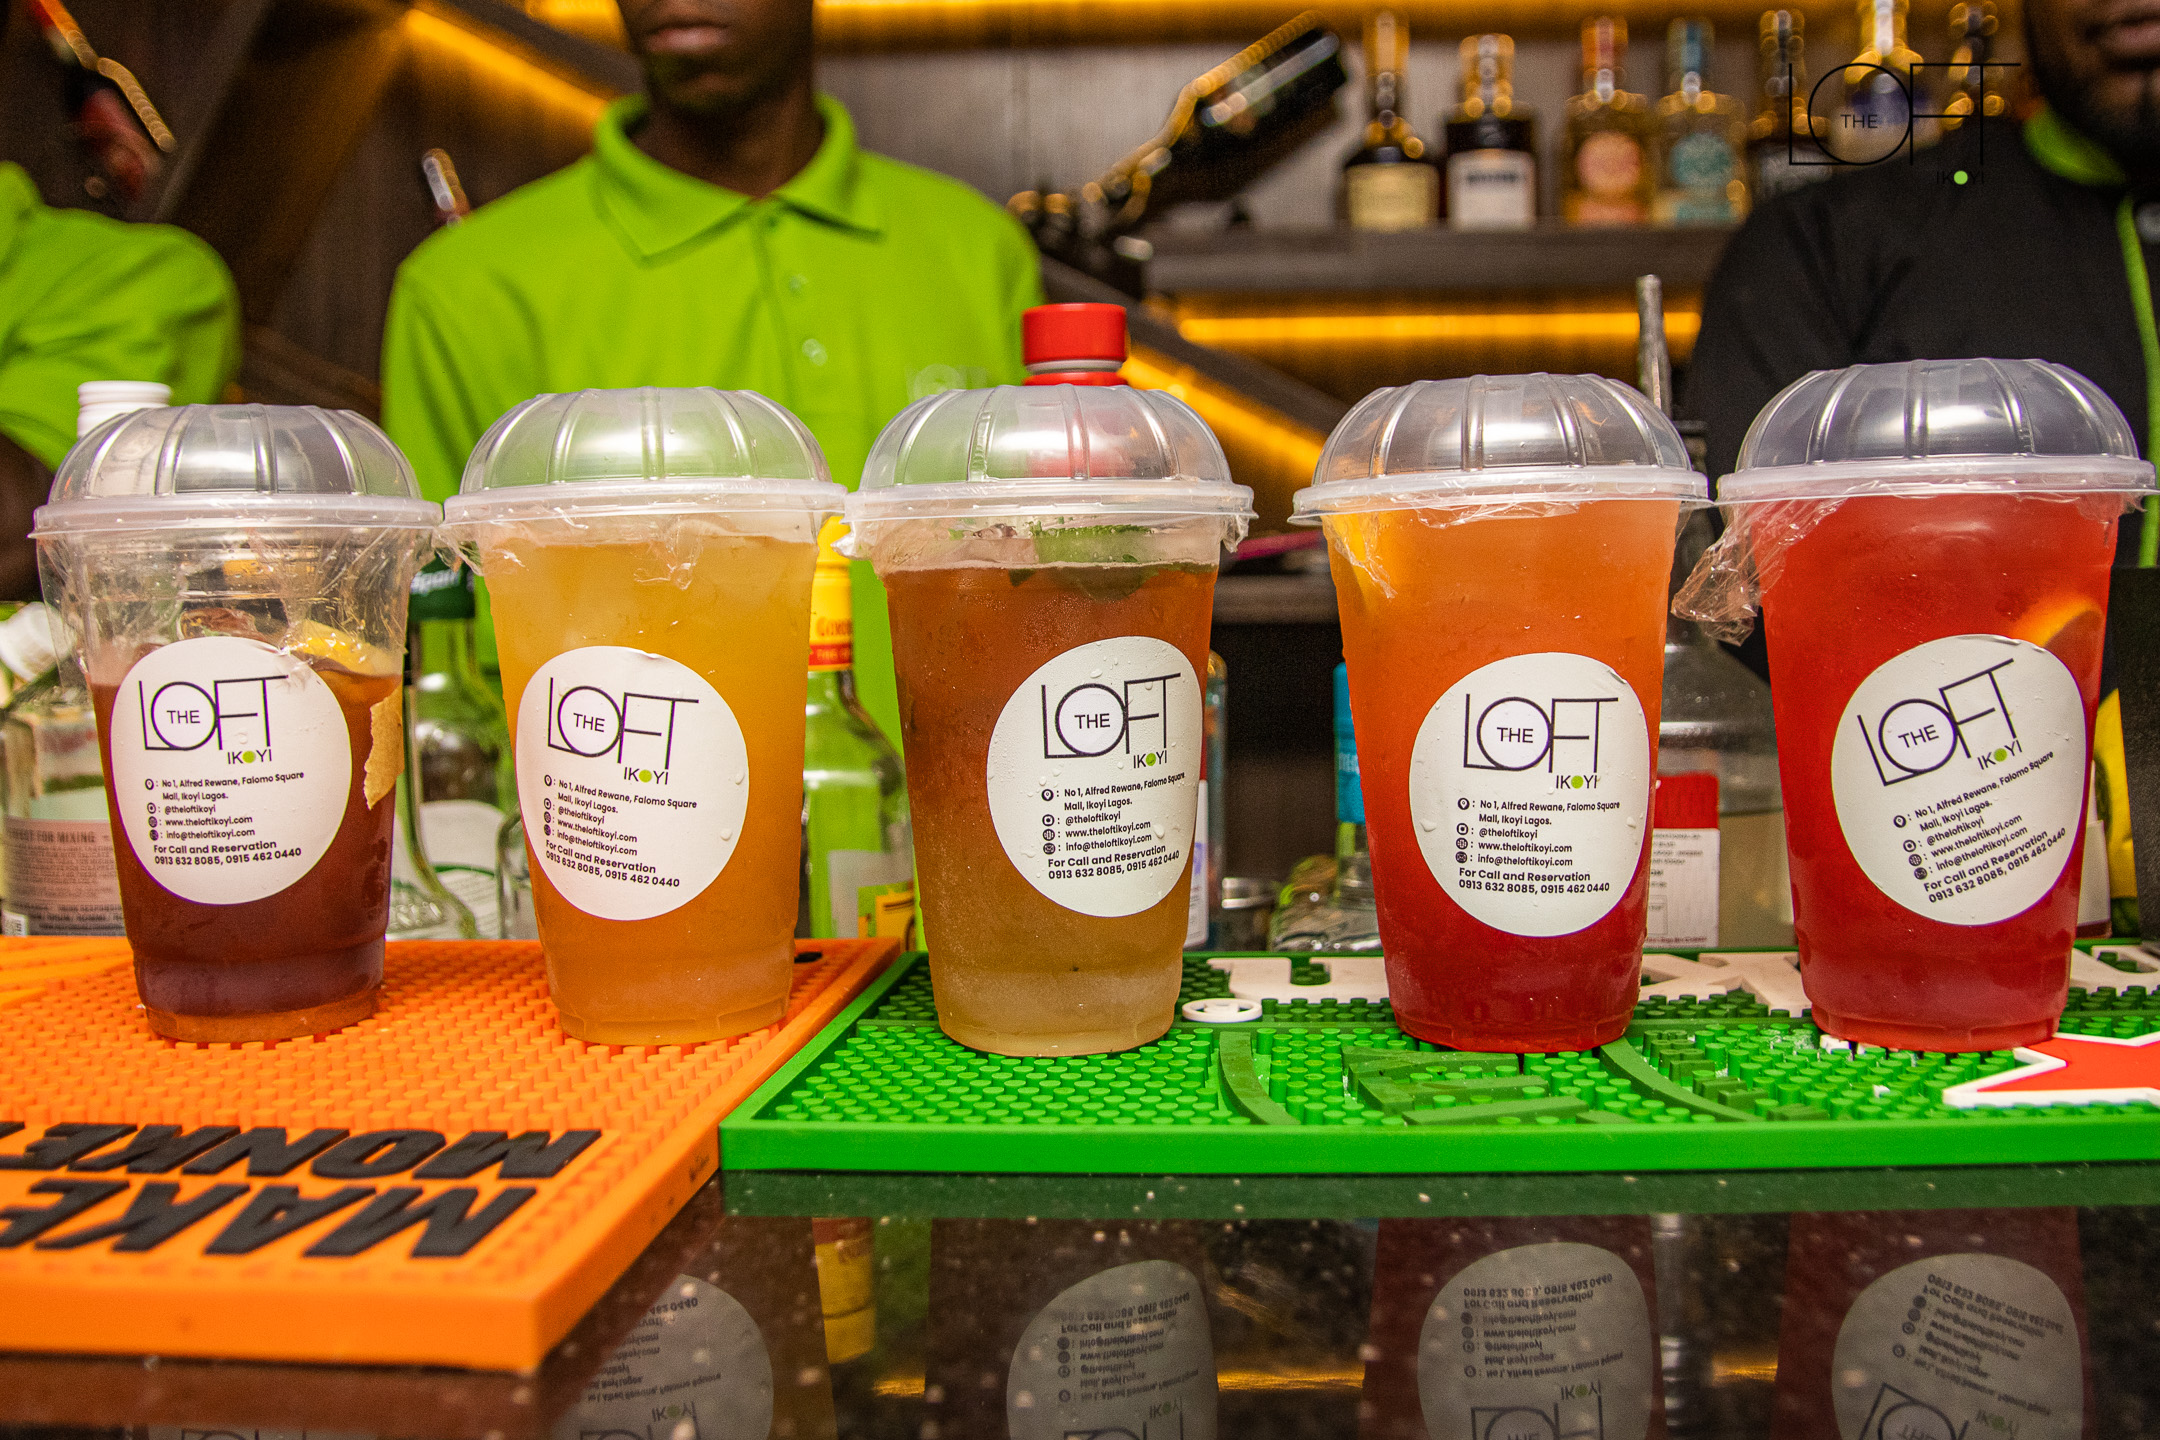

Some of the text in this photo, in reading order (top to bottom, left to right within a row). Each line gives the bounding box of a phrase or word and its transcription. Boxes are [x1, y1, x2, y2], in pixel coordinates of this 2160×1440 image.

[139, 675, 288, 751] LOFT
[167, 710, 200, 724] THE
[574, 713, 604, 732] THE
[1041, 673, 1180, 759] LOFT
[1075, 713, 1110, 729] THE
[1857, 658, 2016, 786] LOFT
[548, 678, 699, 769] LOFT
[1464, 694, 1618, 773] LOFT
[1497, 727, 1533, 743] THE
[1898, 724, 1939, 748] THE
[180, 779, 203, 787] Alfred
[242, 776, 274, 784] Falomo
[275, 772, 304, 783] Square
[1085, 785, 1110, 795] Alfred
[1112, 783, 1143, 793] Rewane,
[1144, 778, 1167, 788] Falomo
[1168, 772, 1184, 784] Square
[1937, 795, 1963, 810] Alfred
[1963, 782, 2000, 800] Rewane,
[2000, 767, 2029, 785] Falomo
[2030, 752, 2053, 770] Square
[182, 792, 200, 802] Ikoyi
[202, 793, 228, 802] Lagos.
[558, 792, 618, 814] Mall, Ikoyi Lagos.
[574, 784, 596, 796] Alfred
[598, 790, 632, 803] Rewane,
[634, 795, 665, 806] Falomo
[667, 799, 697, 810] Square
[1064, 798, 1132, 811] Mall, Ikoyi Lagos.
[1501, 801, 1527, 810] Alfred
[1529, 803, 1565, 812] Rewane,
[1567, 803, 1595, 811] Falomo
[1597, 802, 1620, 812] Square
[165, 804, 216, 815] @theloftikoyi
[558, 806, 604, 825] @theloftikoyi
[1066, 811, 1120, 826] @theloftikoyi
[1920, 801, 1992, 832] Mall, Ikoyi Lagos.
[165, 816, 252, 827] www.theloftikoyi.com
[558, 819, 637, 842] www.theloftikoyi.com
[1066, 822, 1150, 837] www.theloftikoyi.com
[1479, 814, 1552, 827] Mall, Ikoyi Lagos.
[57, 831, 96, 844] MIXING
[166, 829, 255, 841] info@theloftikoyi.com
[1479, 828, 1538, 840] @theloftikoyi
[1927, 816, 1984, 846] @theloftikoyi
[1931, 815, 2022, 857] www.theloftikoyi.com
[154, 845, 166, 853] For
[190, 845, 209, 854] and
[212, 841, 276, 853] Reservation
[558, 830, 637, 856] info@theloftikoyi.com
[1066, 834, 1152, 852] info@theloftikoyi.com
[1478, 842, 1572, 854] www.theloftikoyi.com
[1936, 827, 2027, 870] info@theloftikoyi.com
[155, 848, 301, 865] 0913 632 8085, 0915 462 0440
[546, 840, 656, 873] For Call and Reservation
[1048, 846, 1166, 867] For Call and Reservation
[1048, 850, 1179, 879] 0913 632 8085, 0915 462 0440
[1478, 854, 1572, 868] info@theloftikoyi.com
[1924, 831, 2047, 892] For Call and Reservation
[1929, 828, 2065, 903] 0913 632 8085, 0915 462 0440
[546, 851, 680, 887] 0913 632 8085, 0915 462 0440
[1460, 867, 1590, 881] For Call and Reservation
[1459, 879, 1609, 895] 0913 632 8085, 0915 462 0440
[0, 1120, 601, 1180] MONKE
[0, 1178, 537, 1258] MAKE
